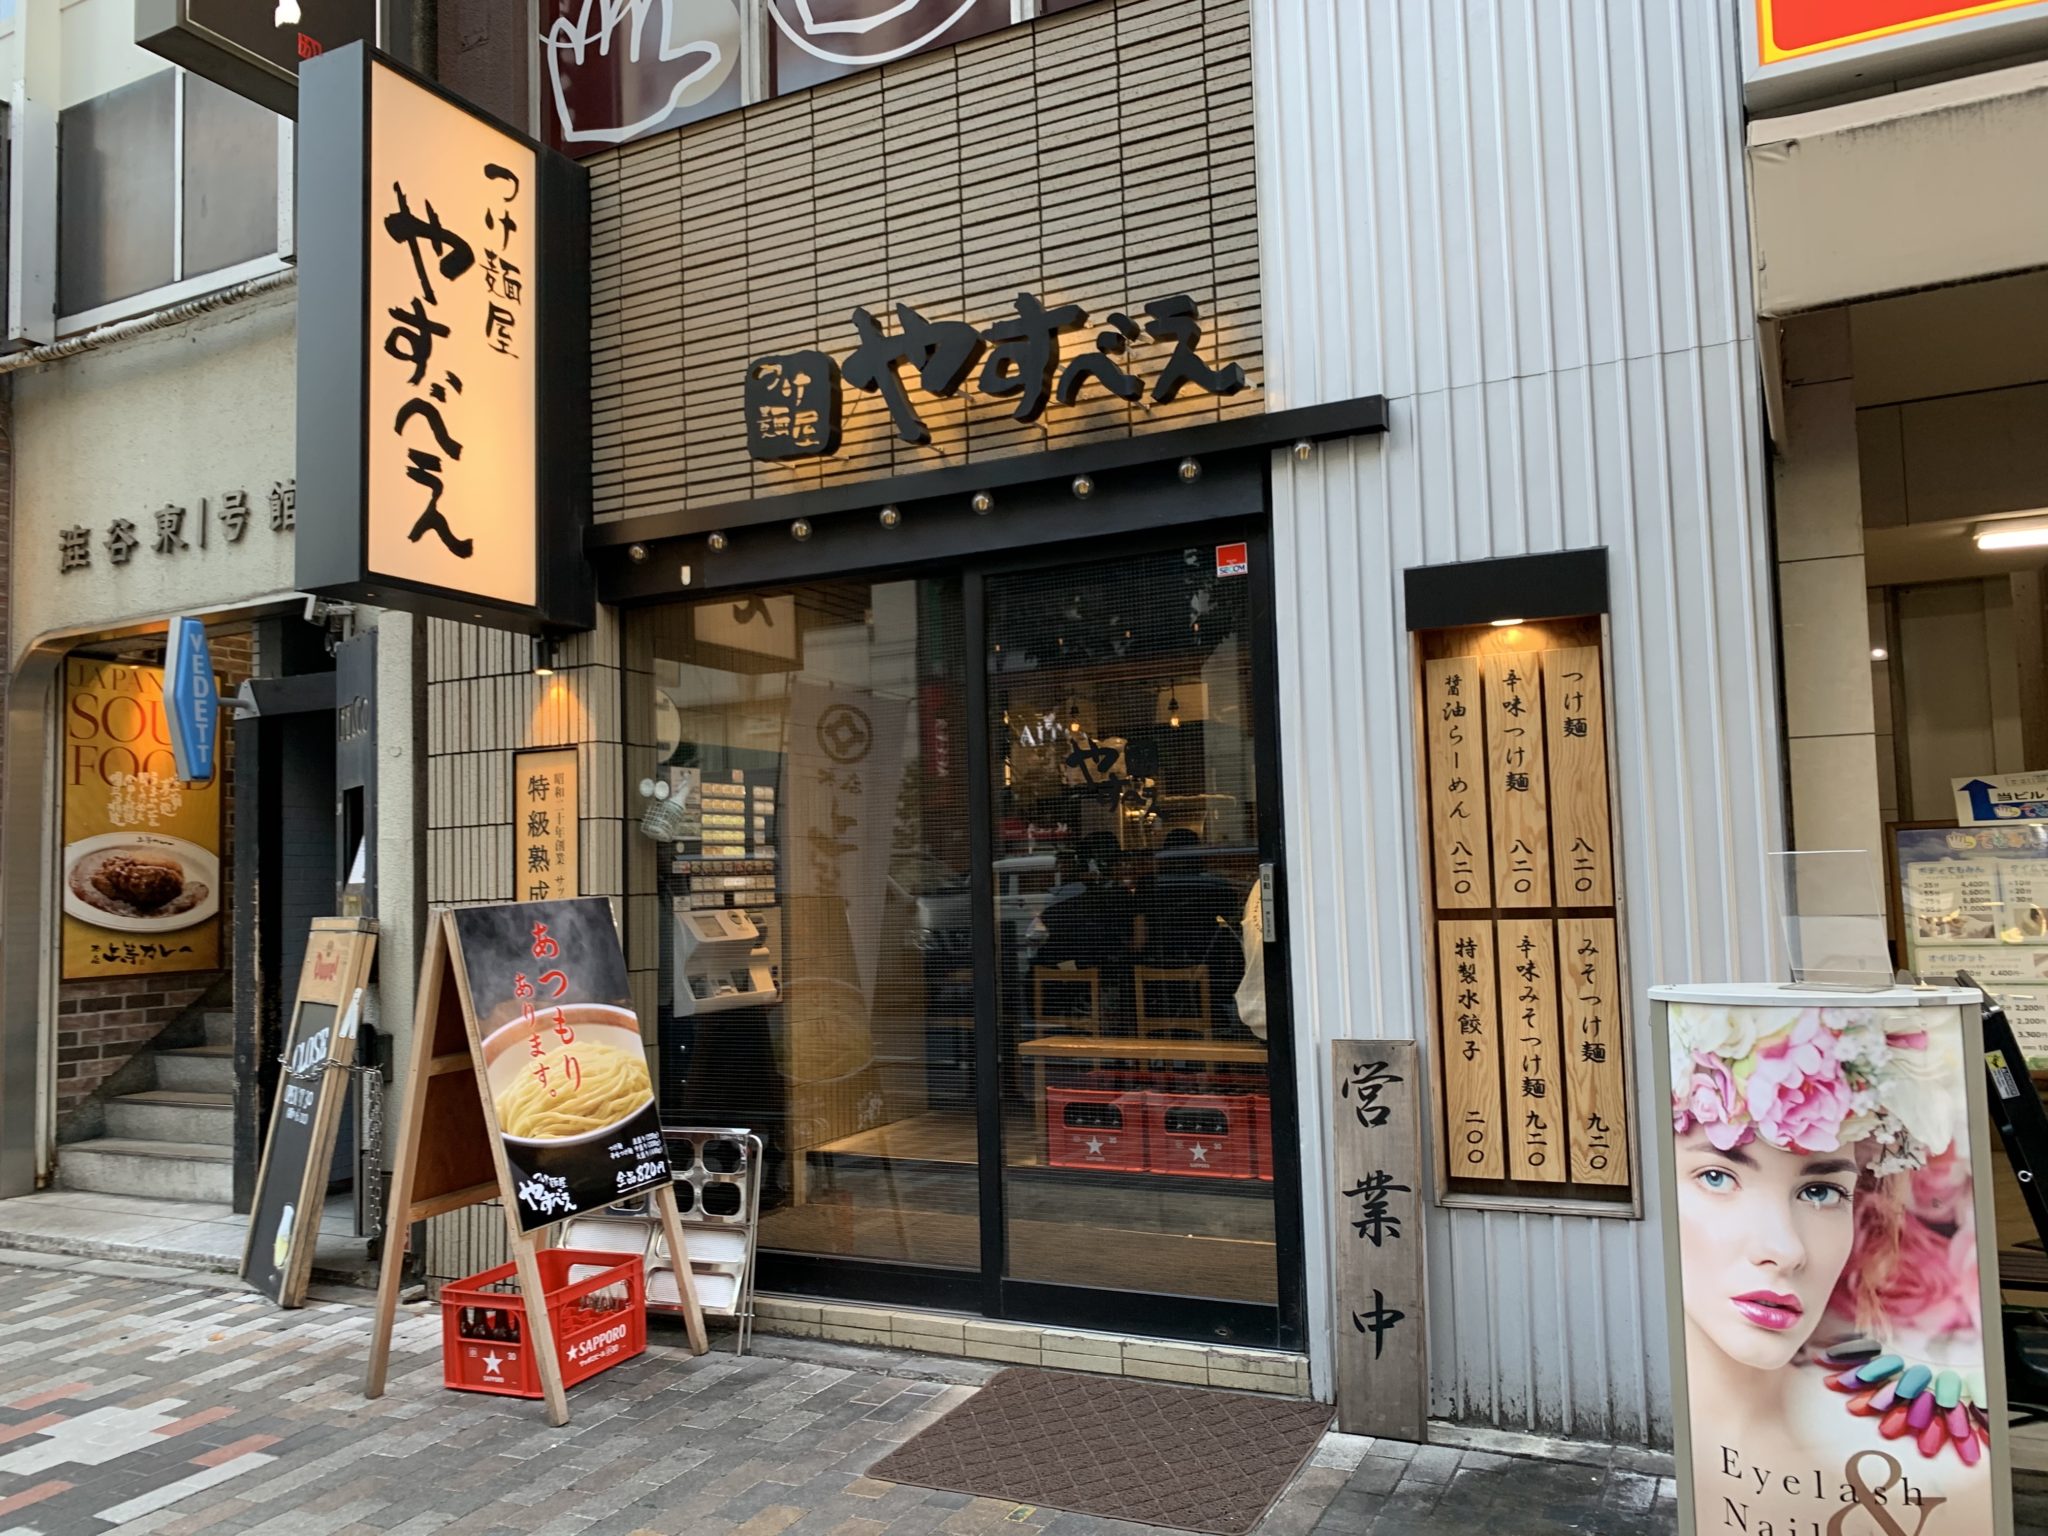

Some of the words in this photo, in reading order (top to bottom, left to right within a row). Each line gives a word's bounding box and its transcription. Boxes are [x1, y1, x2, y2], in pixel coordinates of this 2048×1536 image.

[478, 163, 523, 359] つけ麺屋
[383, 180, 476, 559] やすべえ
[841, 291, 1244, 445] やすべえ
[69, 692, 173, 746] SOU
[190, 633, 210, 763] VEDETT
[1442, 674, 1471, 819] 醤油らーめん
[1502, 669, 1529, 792] 辛味つけ麺
[1561, 671, 1588, 738] つけ麺
[527, 774, 551, 900] 特級熟成
[531, 921, 581, 1091] あつもり
[1455, 937, 1482, 1061] 特製水餃子
[1516, 935, 1546, 1098] 辛味みそつけ麺
[1577, 938, 1606, 1063] みそつけ麺
[518, 1179, 577, 1216] やすべえ
[1342, 1061, 1412, 1361] 営業中
[578, 1323, 627, 1357] SAPPORO
[1720, 1445, 1924, 1506] Eyelash
